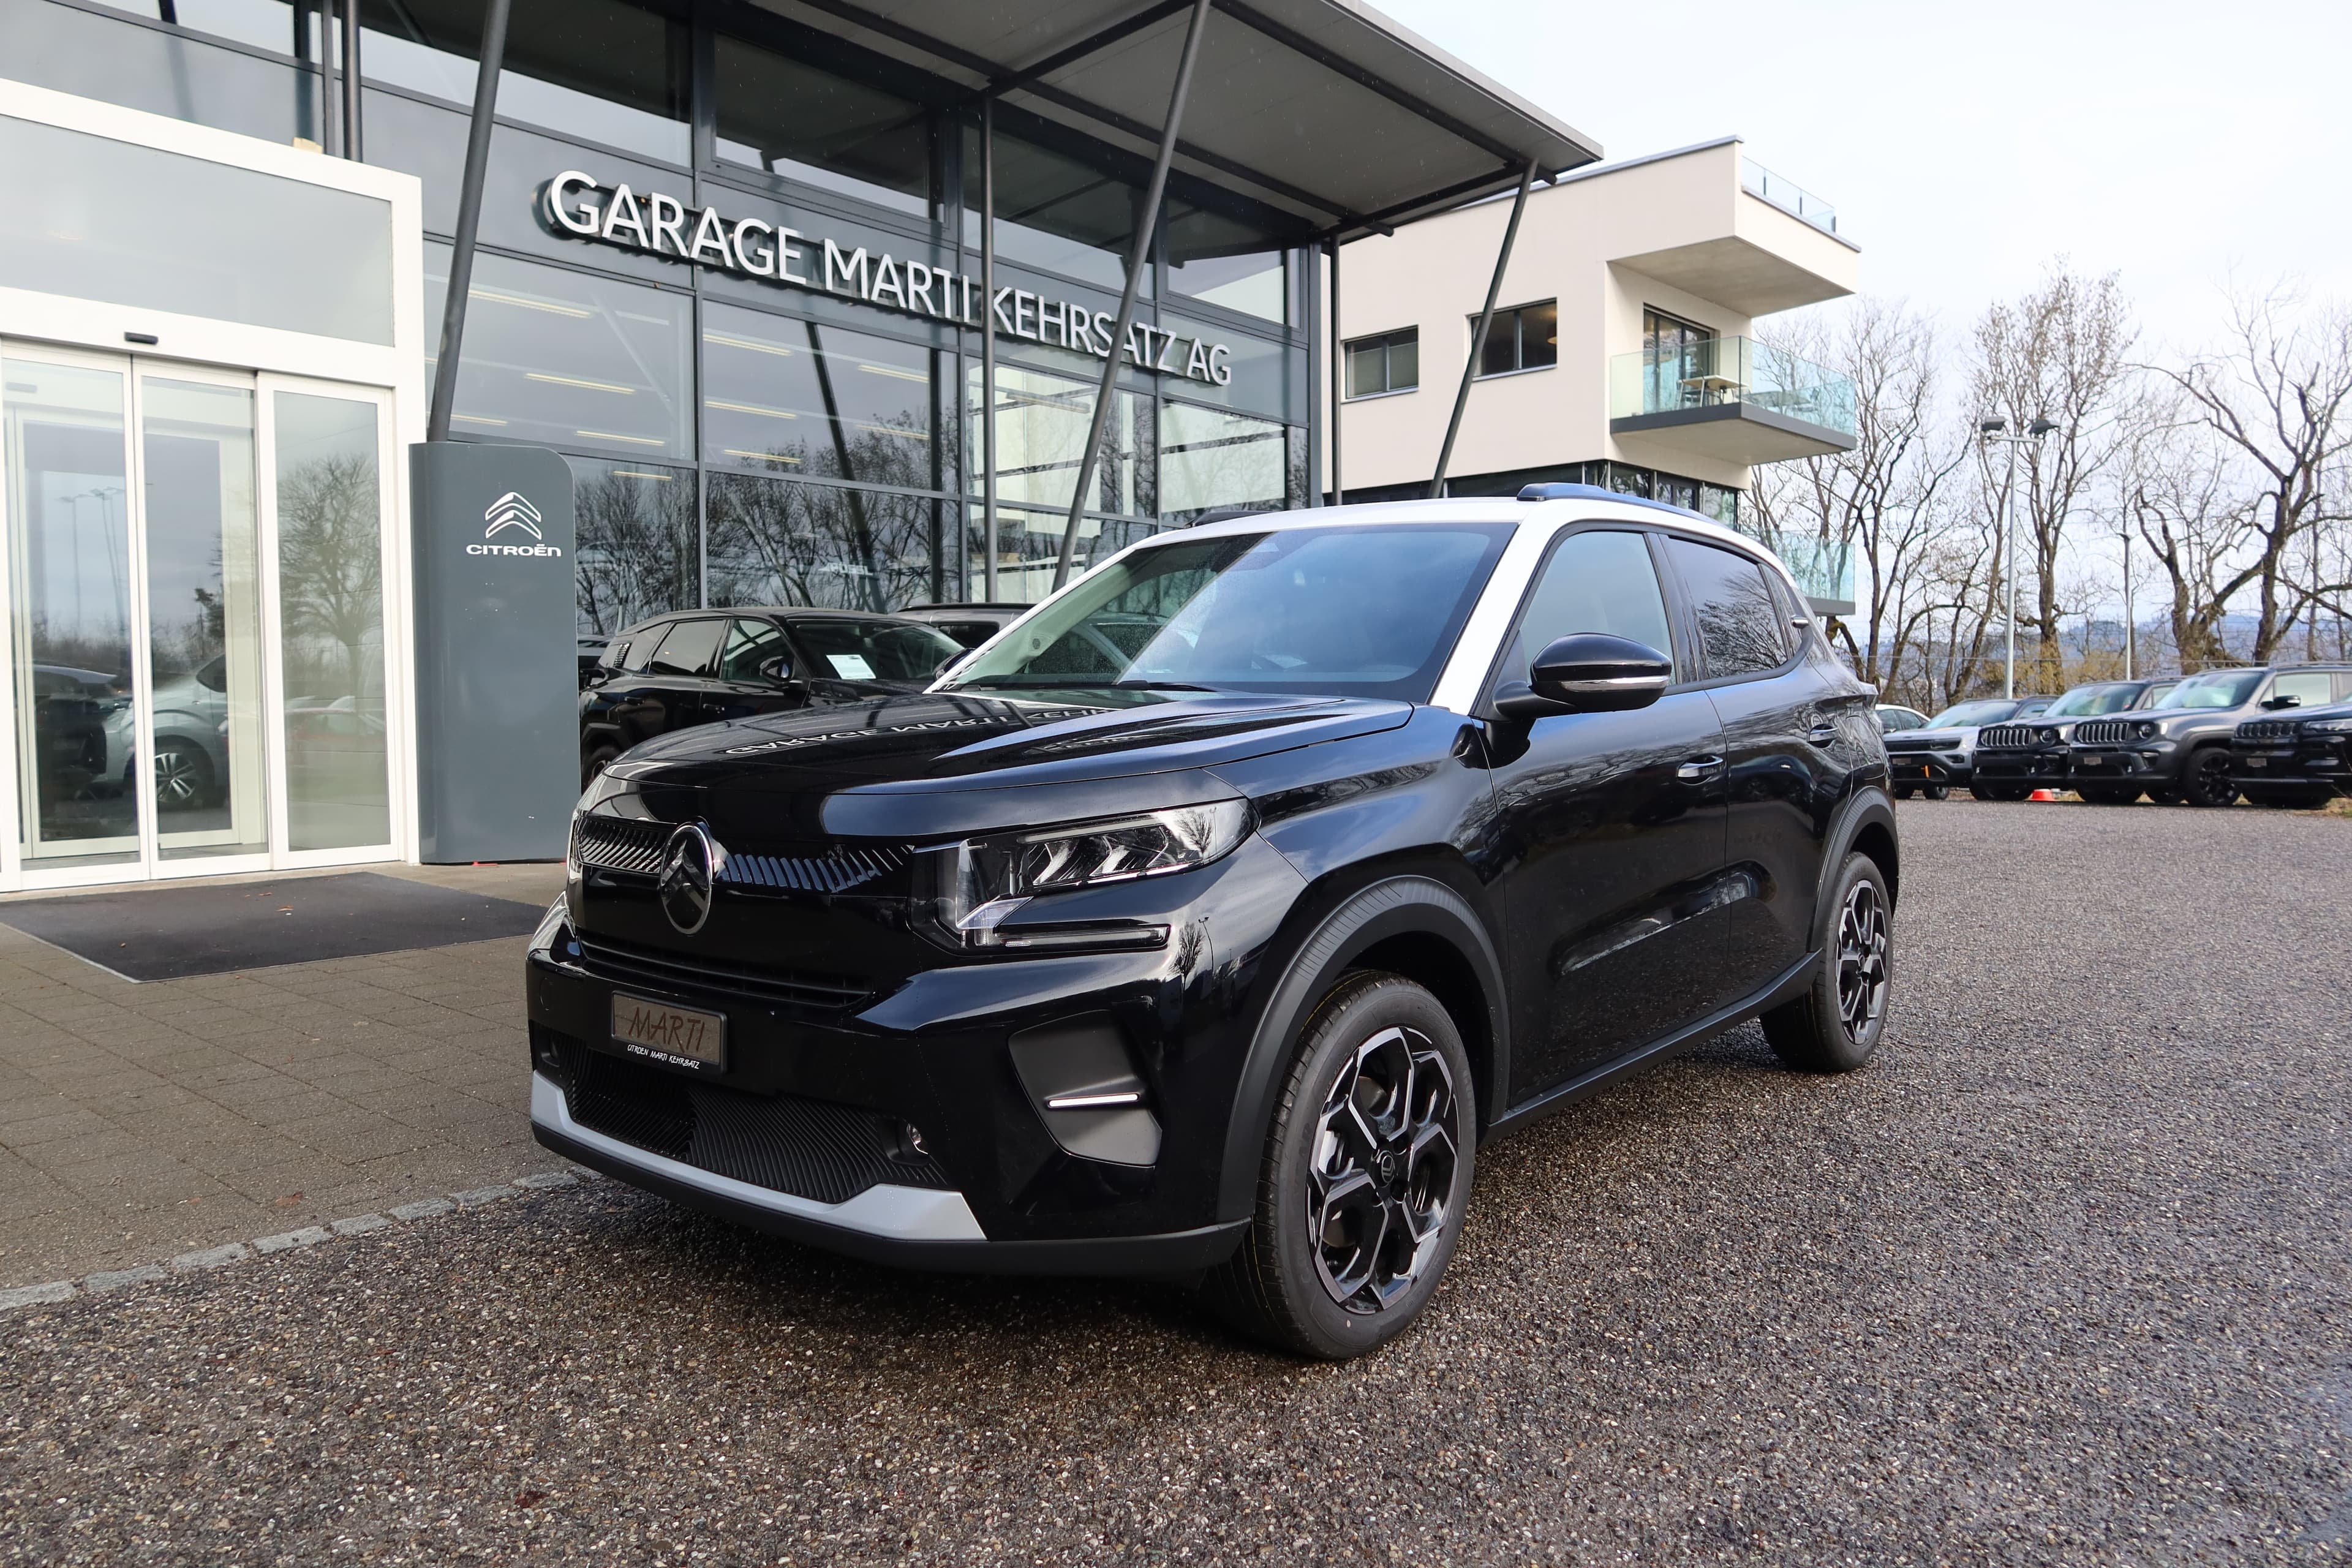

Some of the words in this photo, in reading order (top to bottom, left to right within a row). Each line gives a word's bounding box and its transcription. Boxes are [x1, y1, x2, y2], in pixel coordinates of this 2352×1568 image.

[550, 170, 807, 285] GARAGE
[824, 238, 970, 323] MARTI
[993, 286, 1177, 372] KEHRSATZ
[1186, 337, 1232, 386] AG
[628, 1006, 706, 1054] MARTI
[650, 1050, 668, 1061] MARTI
[669, 1055, 700, 1069] KEHRSATZ
